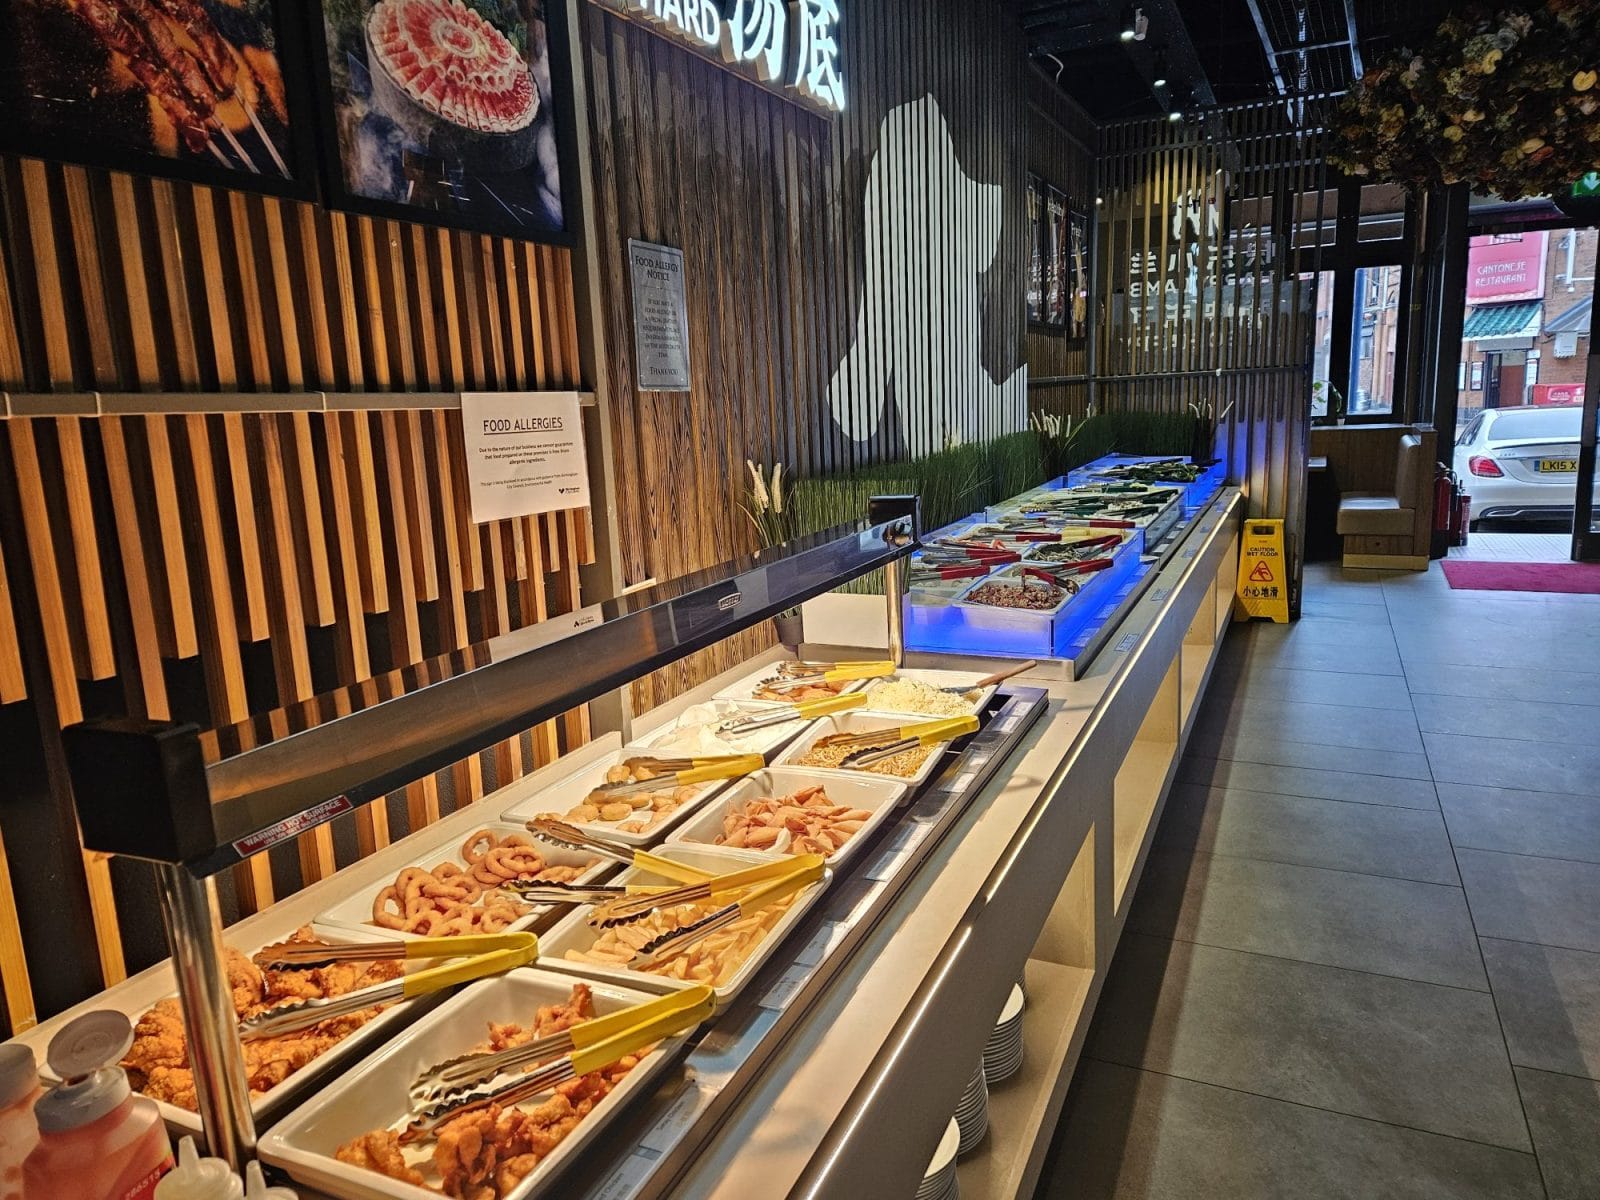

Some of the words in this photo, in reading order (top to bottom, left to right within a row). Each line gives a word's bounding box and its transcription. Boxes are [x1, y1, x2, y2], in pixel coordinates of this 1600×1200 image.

[635, 255, 654, 268] FOOD
[655, 259, 679, 273] ALLERGY
[1477, 261, 1527, 275] CANTONESE
[647, 269, 670, 281] NOTICE
[1475, 273, 1527, 288] RESTAURANT
[483, 418, 511, 433] FOOD
[514, 417, 563, 431] ALLERGIES
[1542, 461, 1567, 471] LK15
[1243, 586, 1279, 598] 小心地滑
[244, 823, 286, 847] WARNING
[286, 815, 304, 829] HOT
[303, 799, 342, 820] SURFACE
